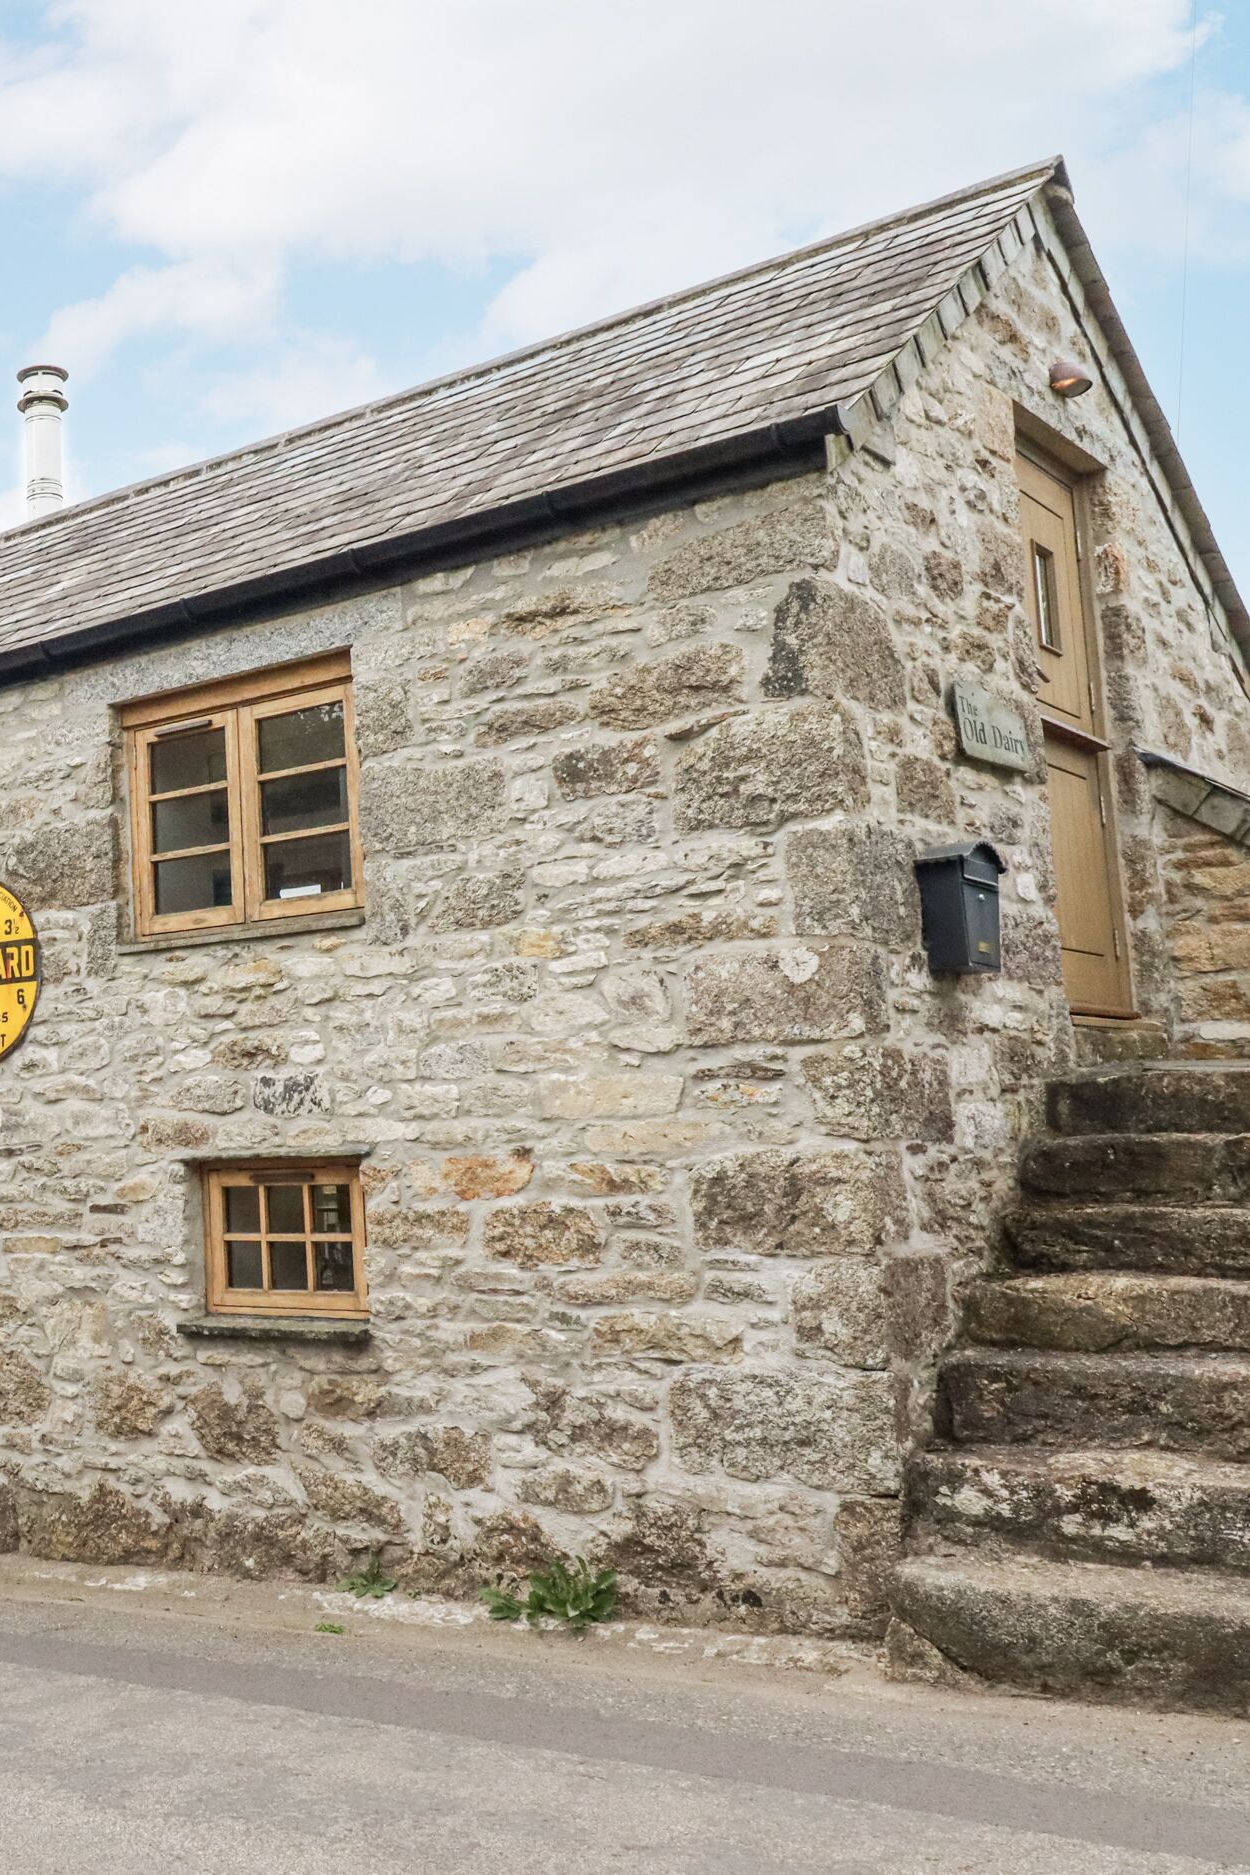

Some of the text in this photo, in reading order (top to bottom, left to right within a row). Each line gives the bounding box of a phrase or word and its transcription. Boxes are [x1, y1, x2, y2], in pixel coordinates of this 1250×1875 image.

[959, 696, 978, 716] The
[963, 717, 1024, 761] Old Dairy
[17, 989, 25, 1004] 6
